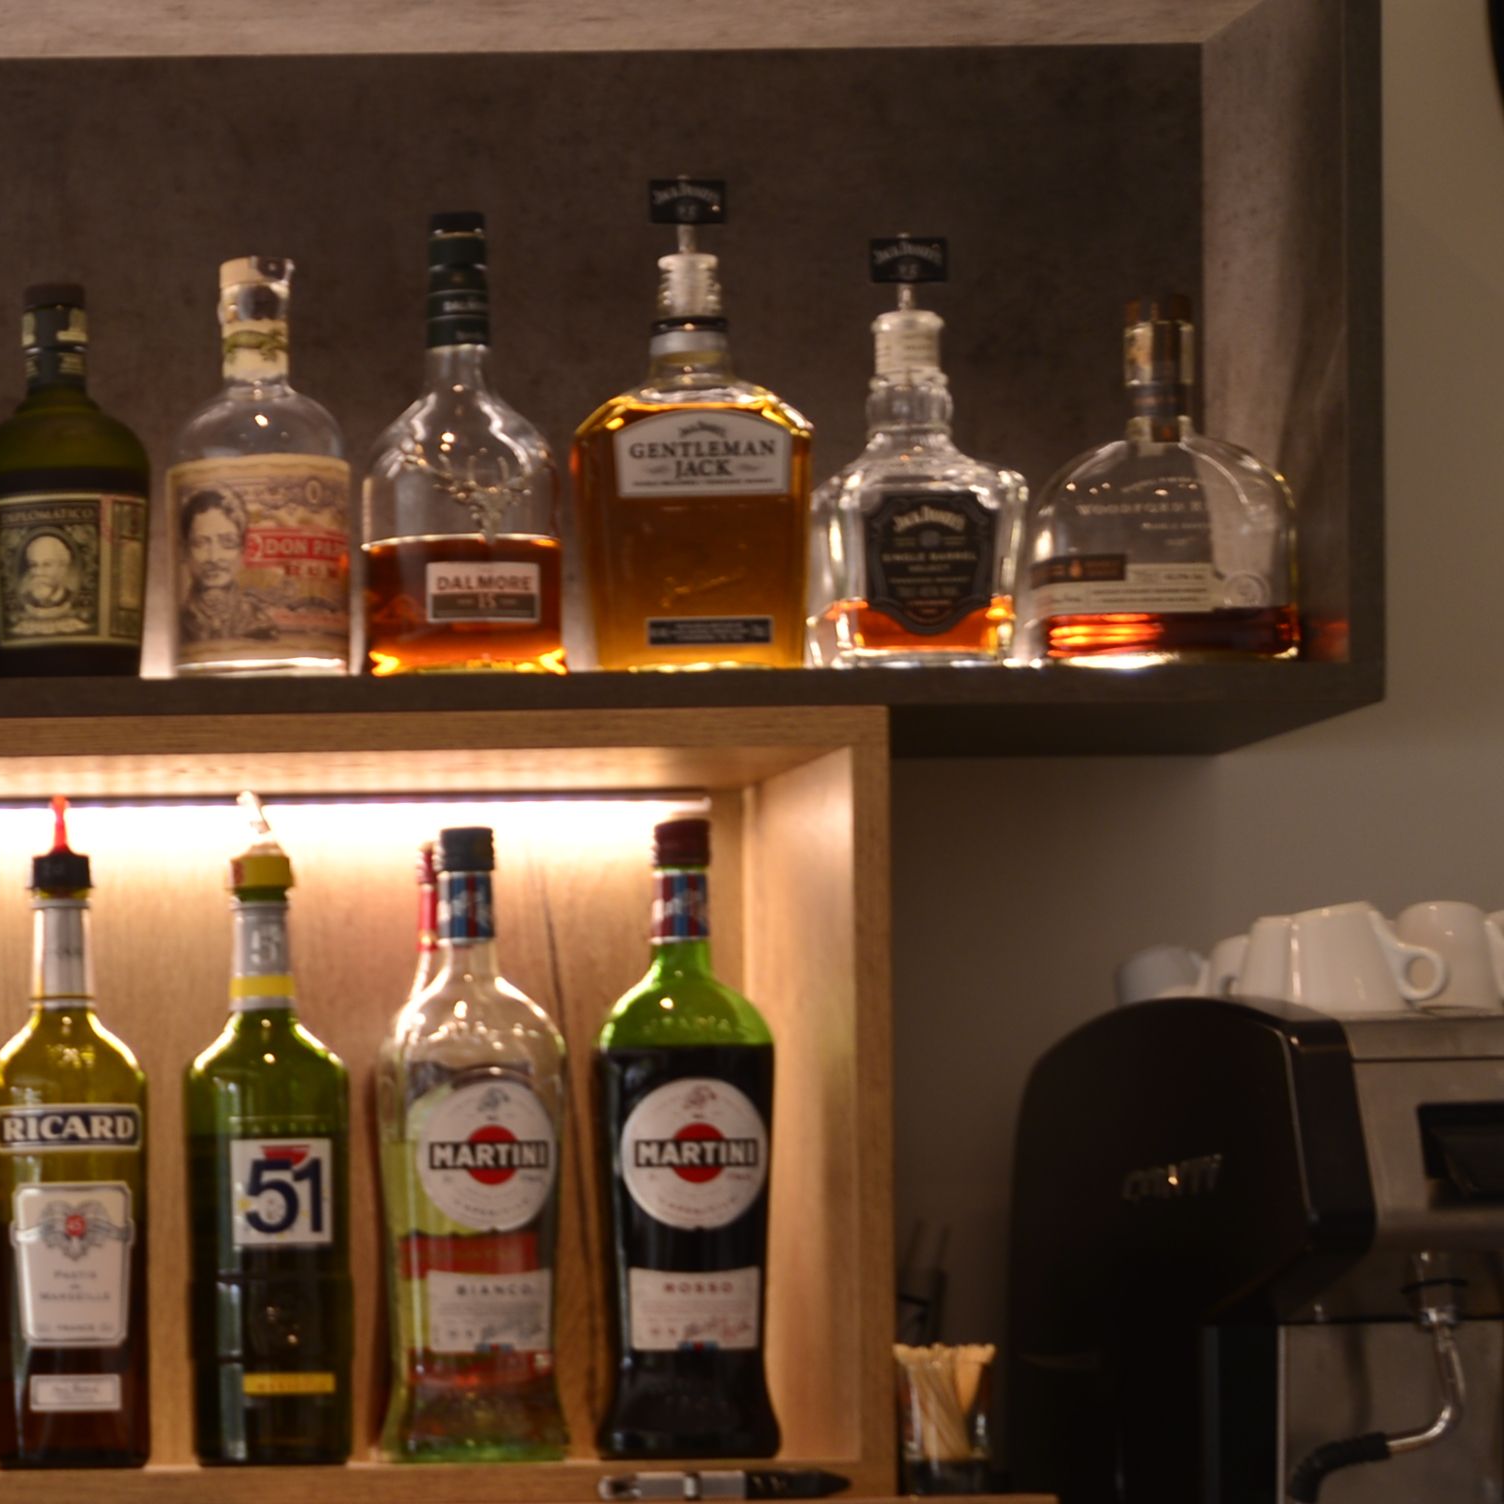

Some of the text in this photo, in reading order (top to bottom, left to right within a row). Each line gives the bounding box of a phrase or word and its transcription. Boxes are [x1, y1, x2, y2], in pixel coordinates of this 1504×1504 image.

[629, 440, 775, 459] GENTLEMAN
[675, 460, 733, 479] JACK
[437, 576, 531, 591] DALMORE
[3, 1115, 135, 1142] RICARD
[433, 1143, 545, 1168] MARTINI
[639, 1141, 755, 1166] MARTINI
[246, 1157, 323, 1233] 51
[456, 1284, 533, 1296] BIANCO
[664, 1281, 733, 1293] ROSSO
